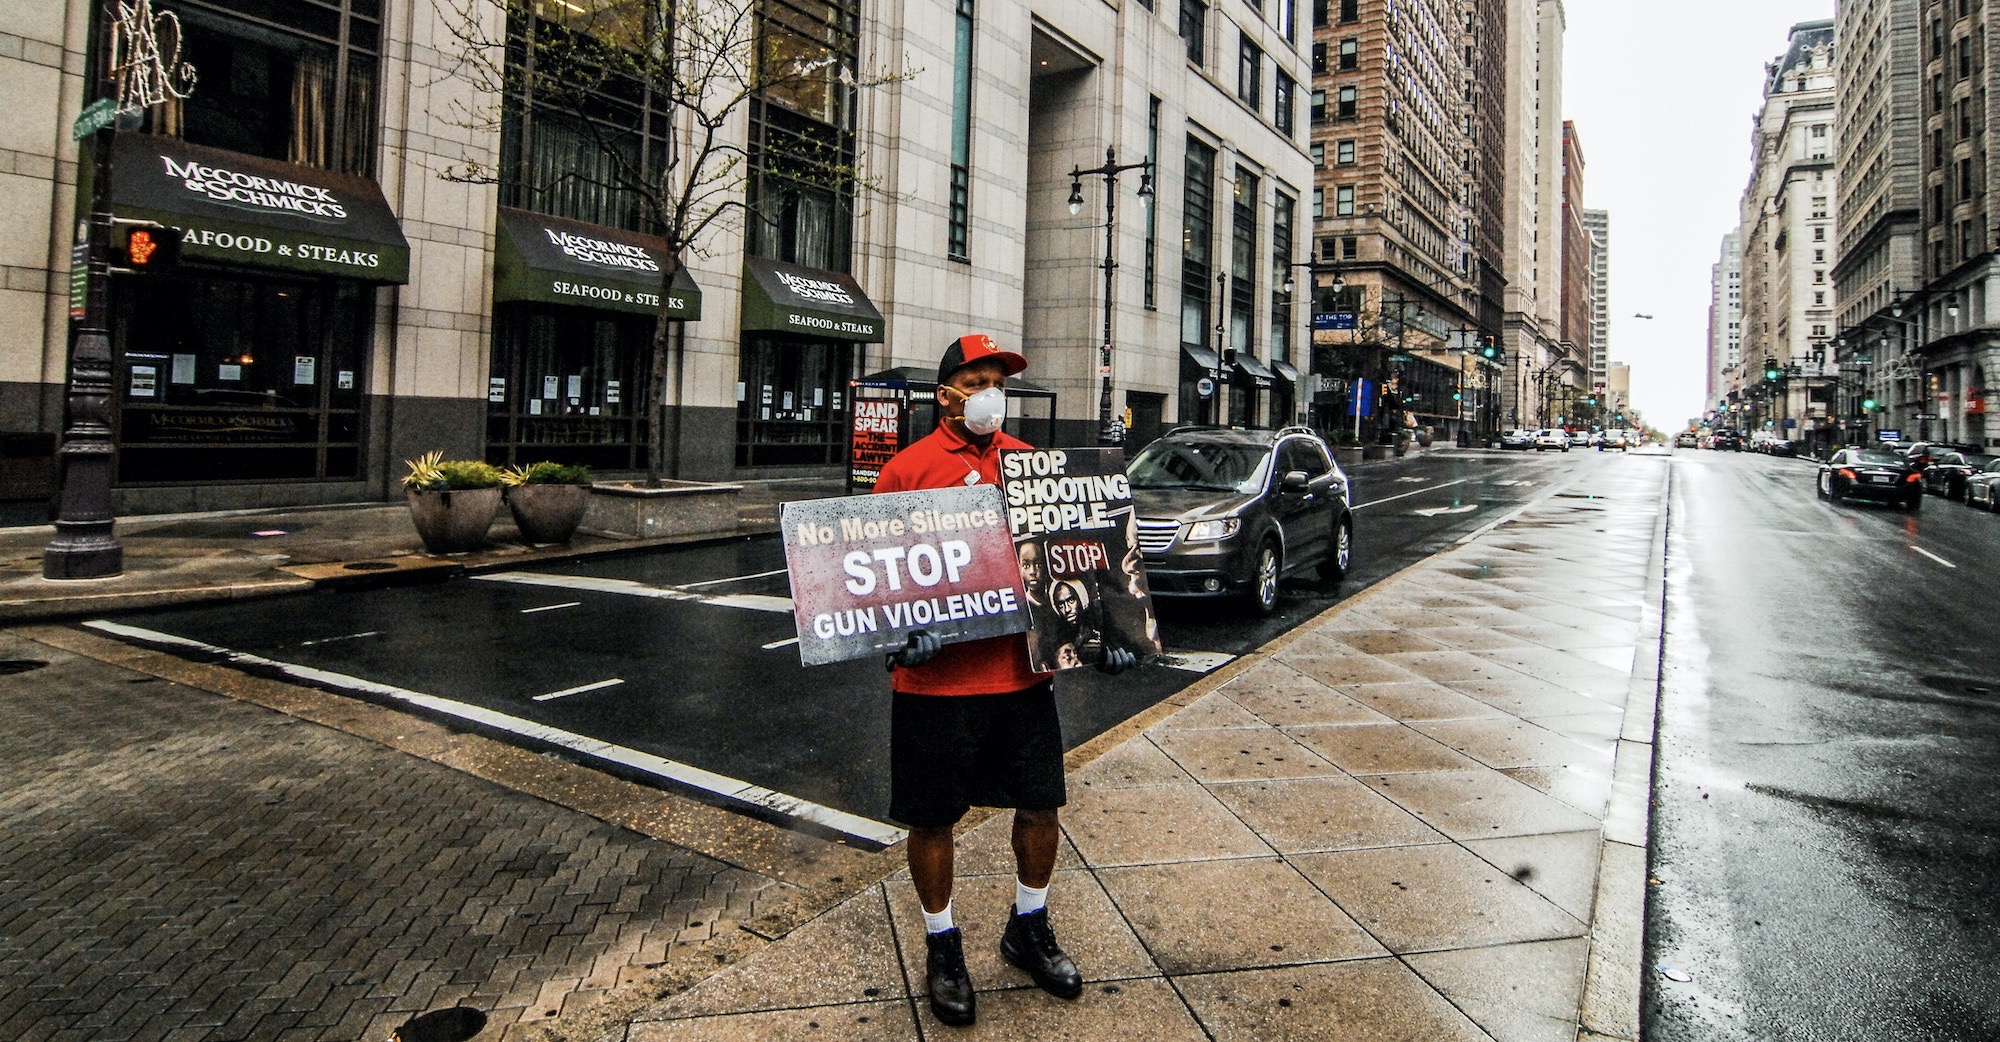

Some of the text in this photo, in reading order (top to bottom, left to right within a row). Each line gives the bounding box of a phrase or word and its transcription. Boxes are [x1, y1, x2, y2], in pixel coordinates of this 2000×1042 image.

[278, 244, 292, 256] &
[297, 244, 379, 268] STEAKS
[553, 281, 684, 309] SEAFOOD & STEKS
[789, 314, 873, 335] SEAFOOD & STEAKS
[855, 401, 899, 419] RAND
[854, 417, 898, 433] SPEAR
[868, 432, 886, 443] THE
[854, 442, 898, 453] ACCIDENT
[1003, 450, 1067, 478] STOP.
[1006, 474, 1132, 506] SHOOTING
[797, 509, 999, 547] No More Silence
[1010, 502, 1116, 534] PEOPLE.
[843, 539, 971, 596] STOP
[1050, 544, 1102, 574] STOP
[813, 587, 1019, 639] GUN VIOLENCE
